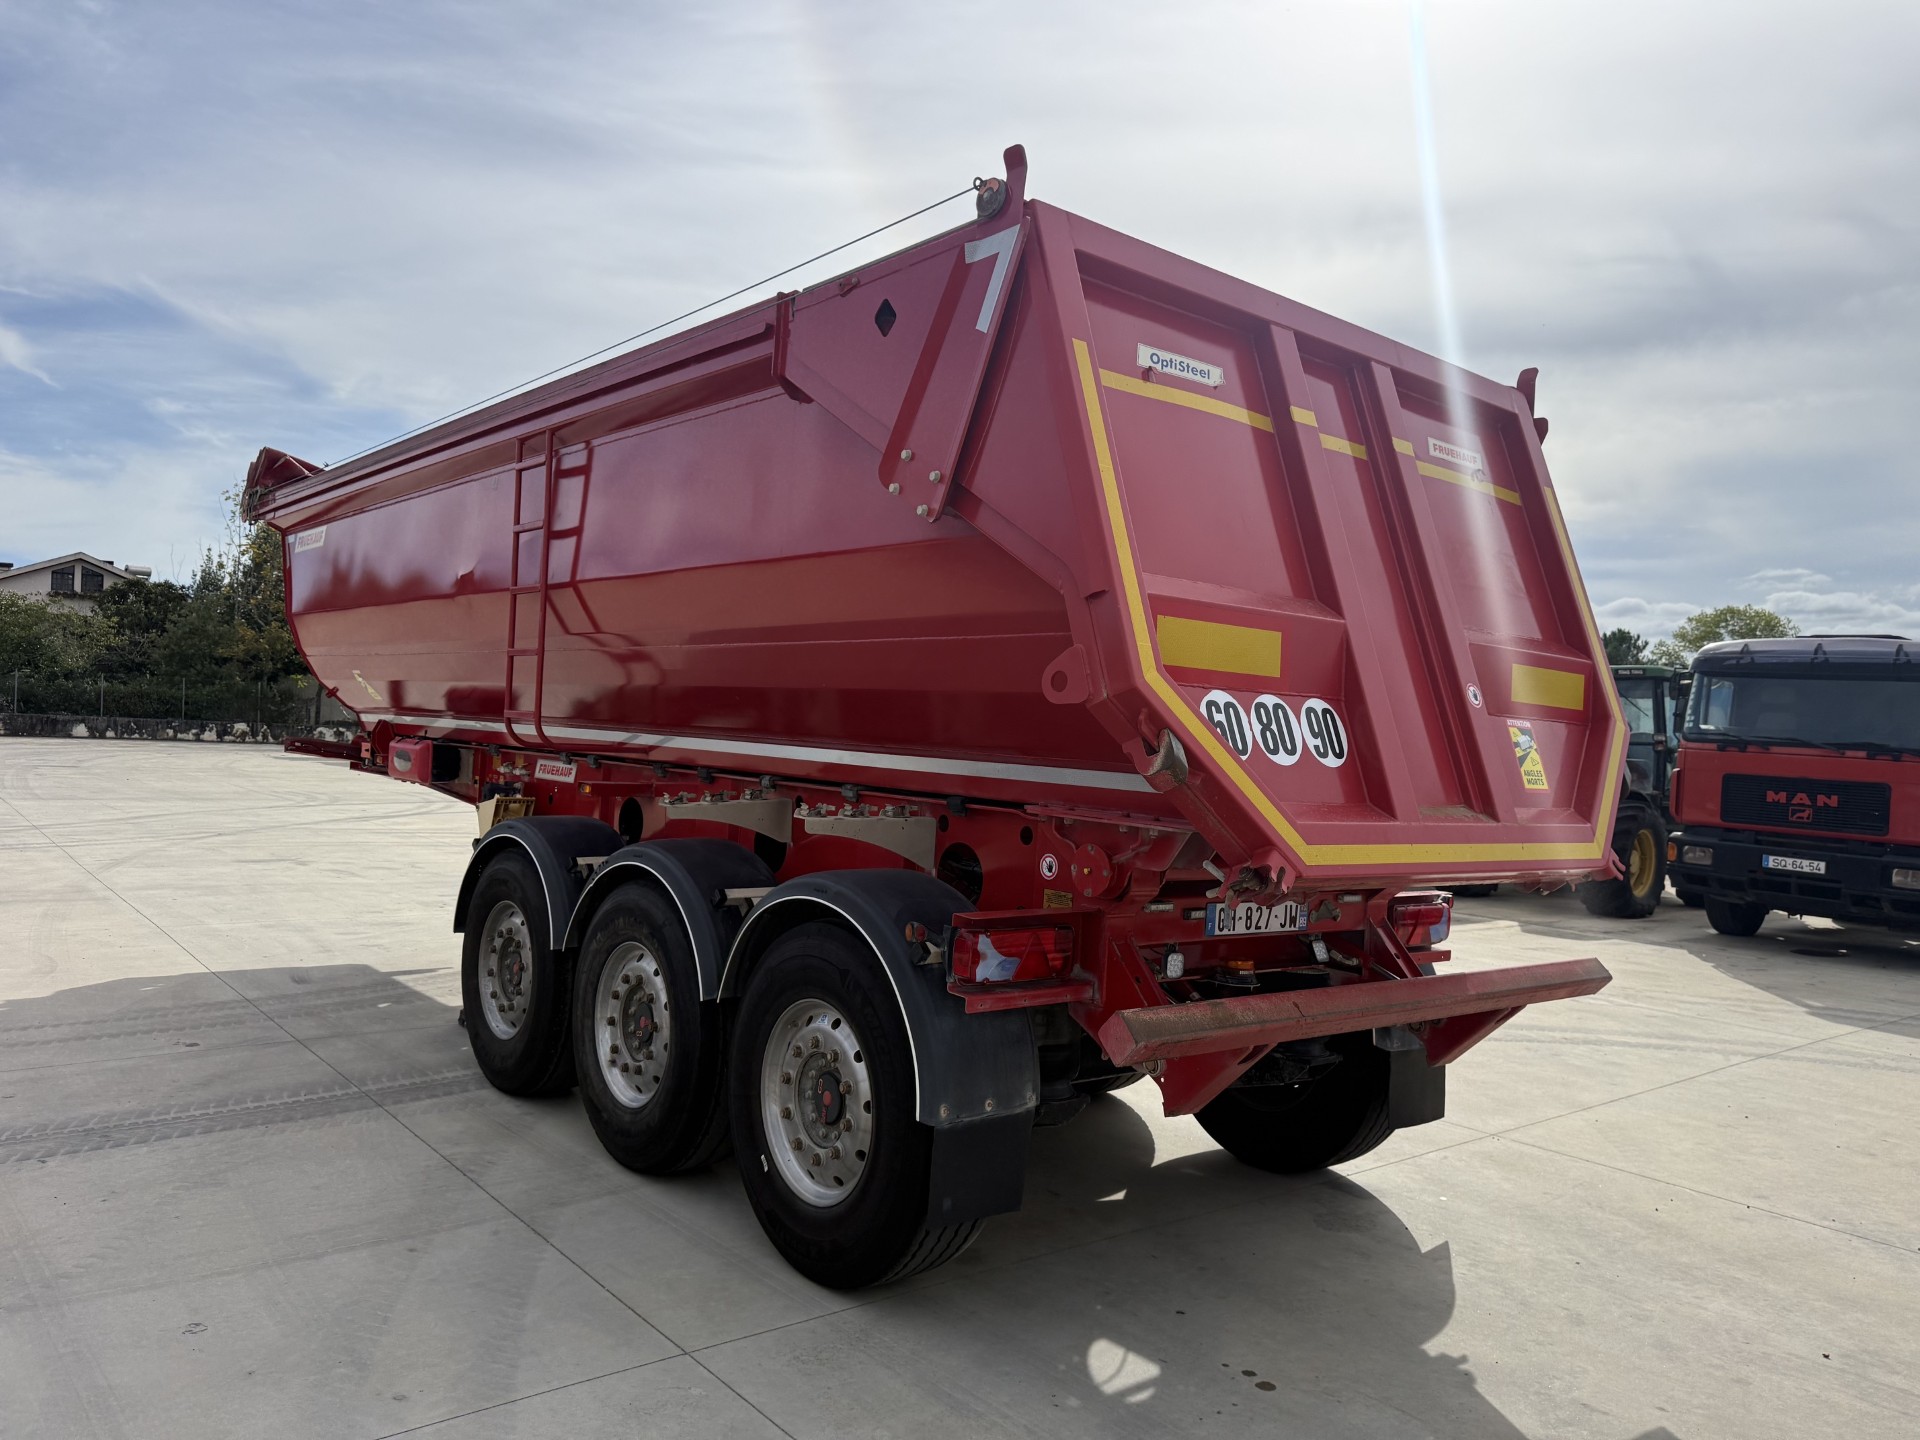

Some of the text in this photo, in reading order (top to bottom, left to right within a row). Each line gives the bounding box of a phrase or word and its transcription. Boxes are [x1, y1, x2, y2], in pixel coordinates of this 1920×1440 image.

[1149, 352, 1211, 380] OptiSteel
[1432, 442, 1478, 465] FRUEHAUF
[1205, 699, 1345, 760] 60 80 90
[538, 763, 574, 778] FRUEHAUF
[1523, 769, 1543, 778] ANGLES
[1526, 778, 1545, 786] MORTS
[1766, 790, 1839, 808] MAN
